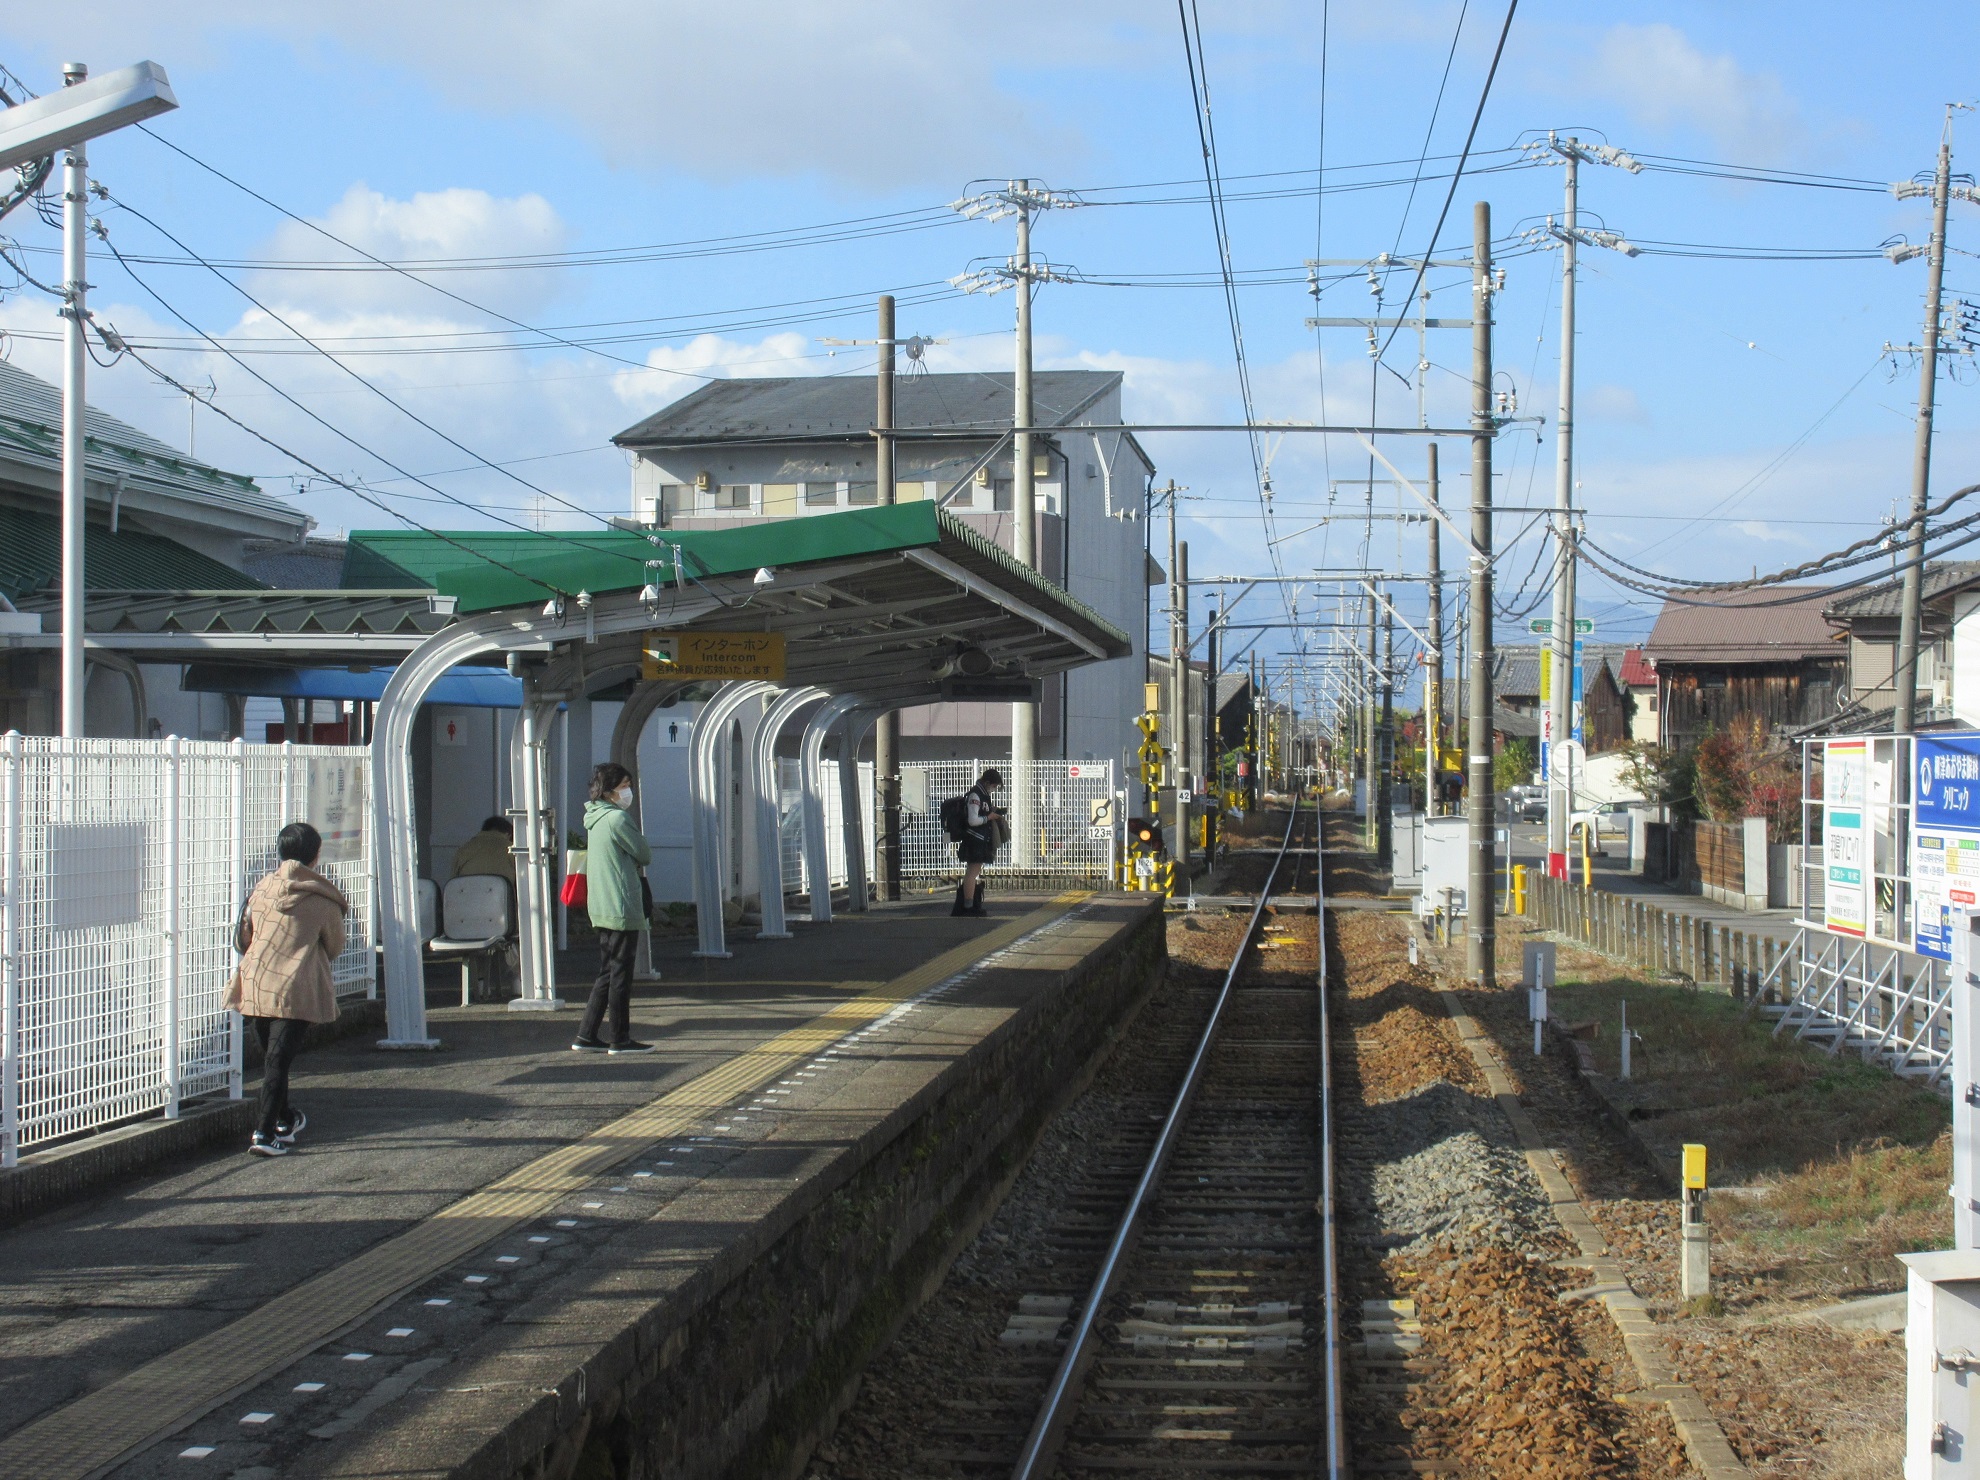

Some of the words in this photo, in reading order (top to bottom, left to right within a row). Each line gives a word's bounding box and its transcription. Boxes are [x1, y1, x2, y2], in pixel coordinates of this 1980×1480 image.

[690, 638, 770, 651] インターホン
[702, 653, 756, 662] Intercom
[656, 664, 771, 675] 名鉄係員が応対いたします
[1178, 792, 1190, 800] 42
[1943, 785, 1969, 811] クリニック
[1089, 828, 1113, 838] 123共
